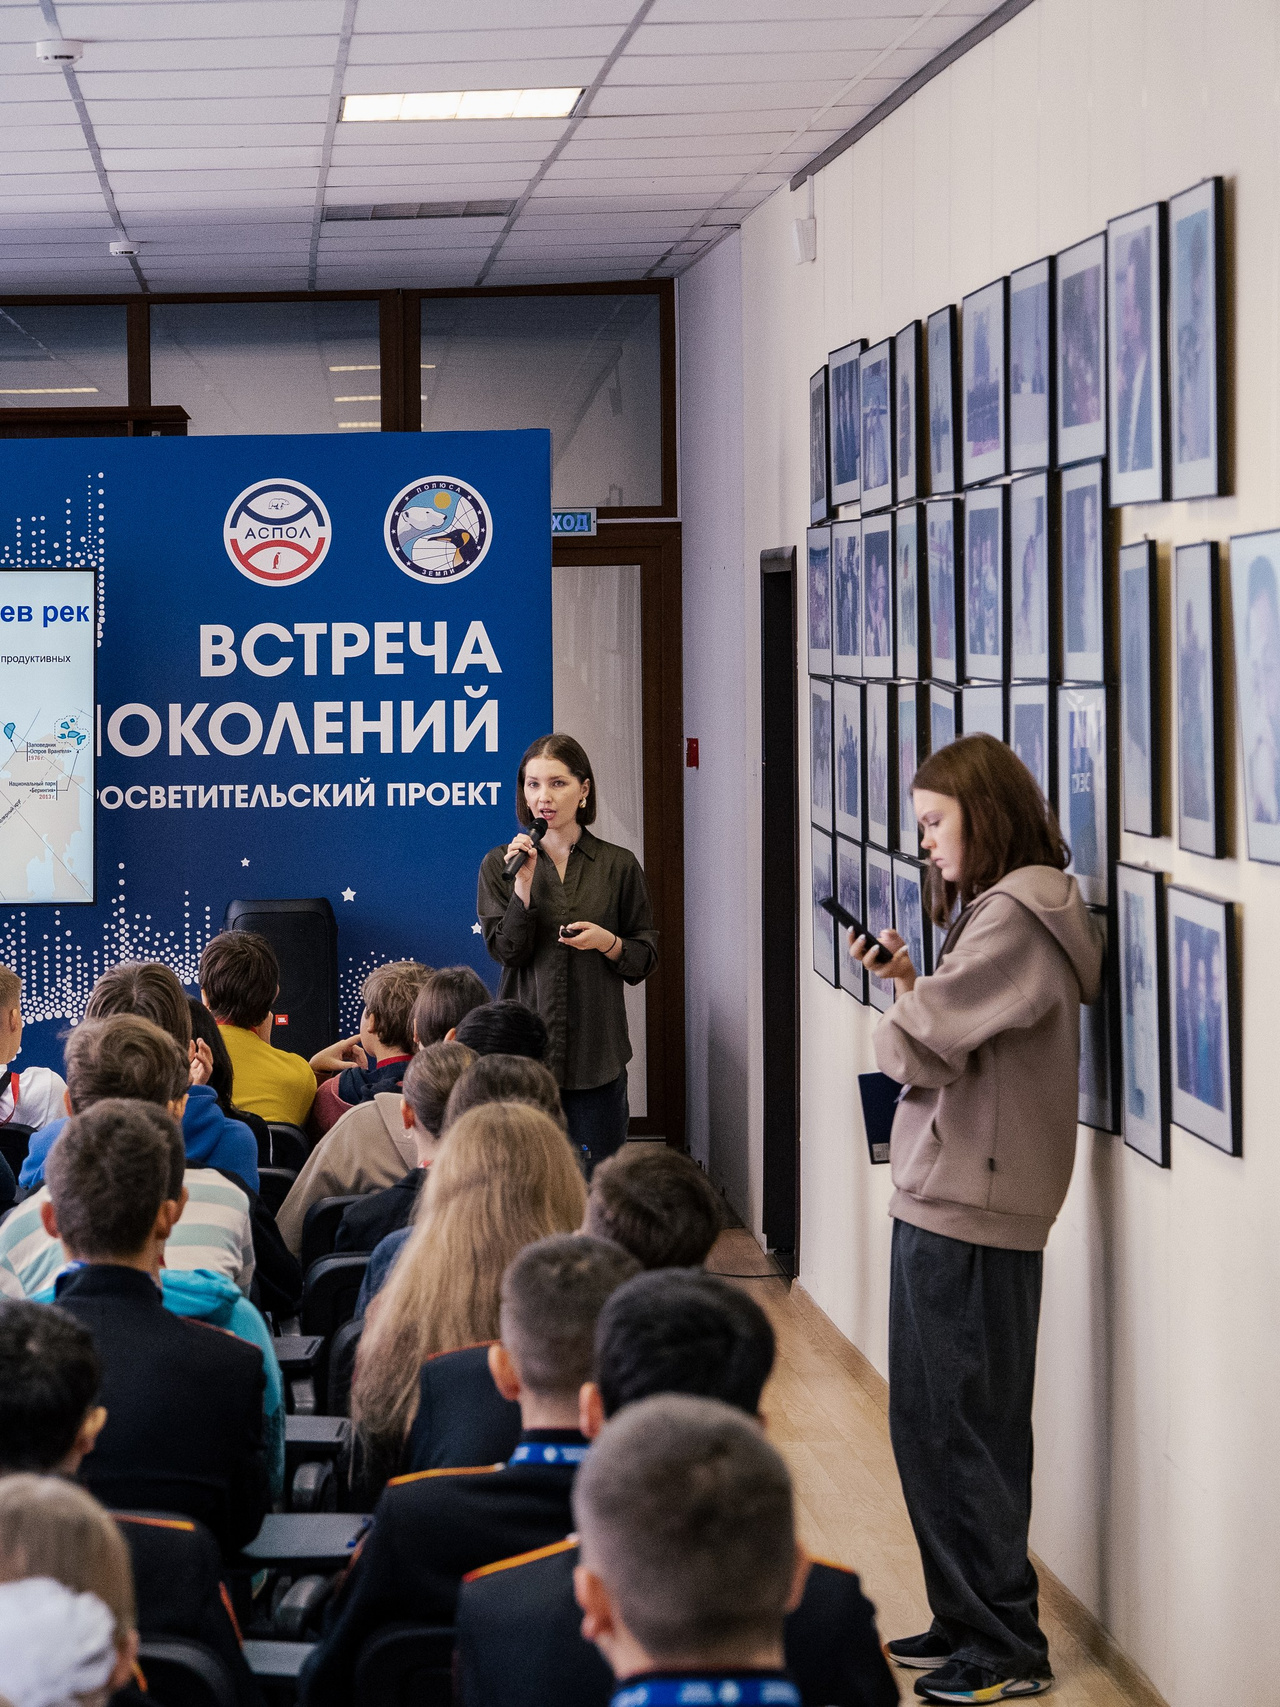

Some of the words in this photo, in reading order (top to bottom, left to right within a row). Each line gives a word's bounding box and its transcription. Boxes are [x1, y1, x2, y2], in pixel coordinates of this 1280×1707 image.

[416, 483, 460, 494] ПОЛЮСА
[552, 514, 588, 531] ХОД
[244, 526, 312, 541] АСПОЛ
[422, 568, 455, 576] ЗЕМЛИ
[43, 605, 90, 628] рек
[200, 620, 502, 678] ВСТРЕЧА
[1, 655, 70, 665] продуктивных
[97, 685, 499, 757] ОКОЛЕНИЙ
[97, 777, 375, 810] ОСВЕТИТЕЛЬСКИЙ
[388, 782, 502, 806] ПРОЕКТ
